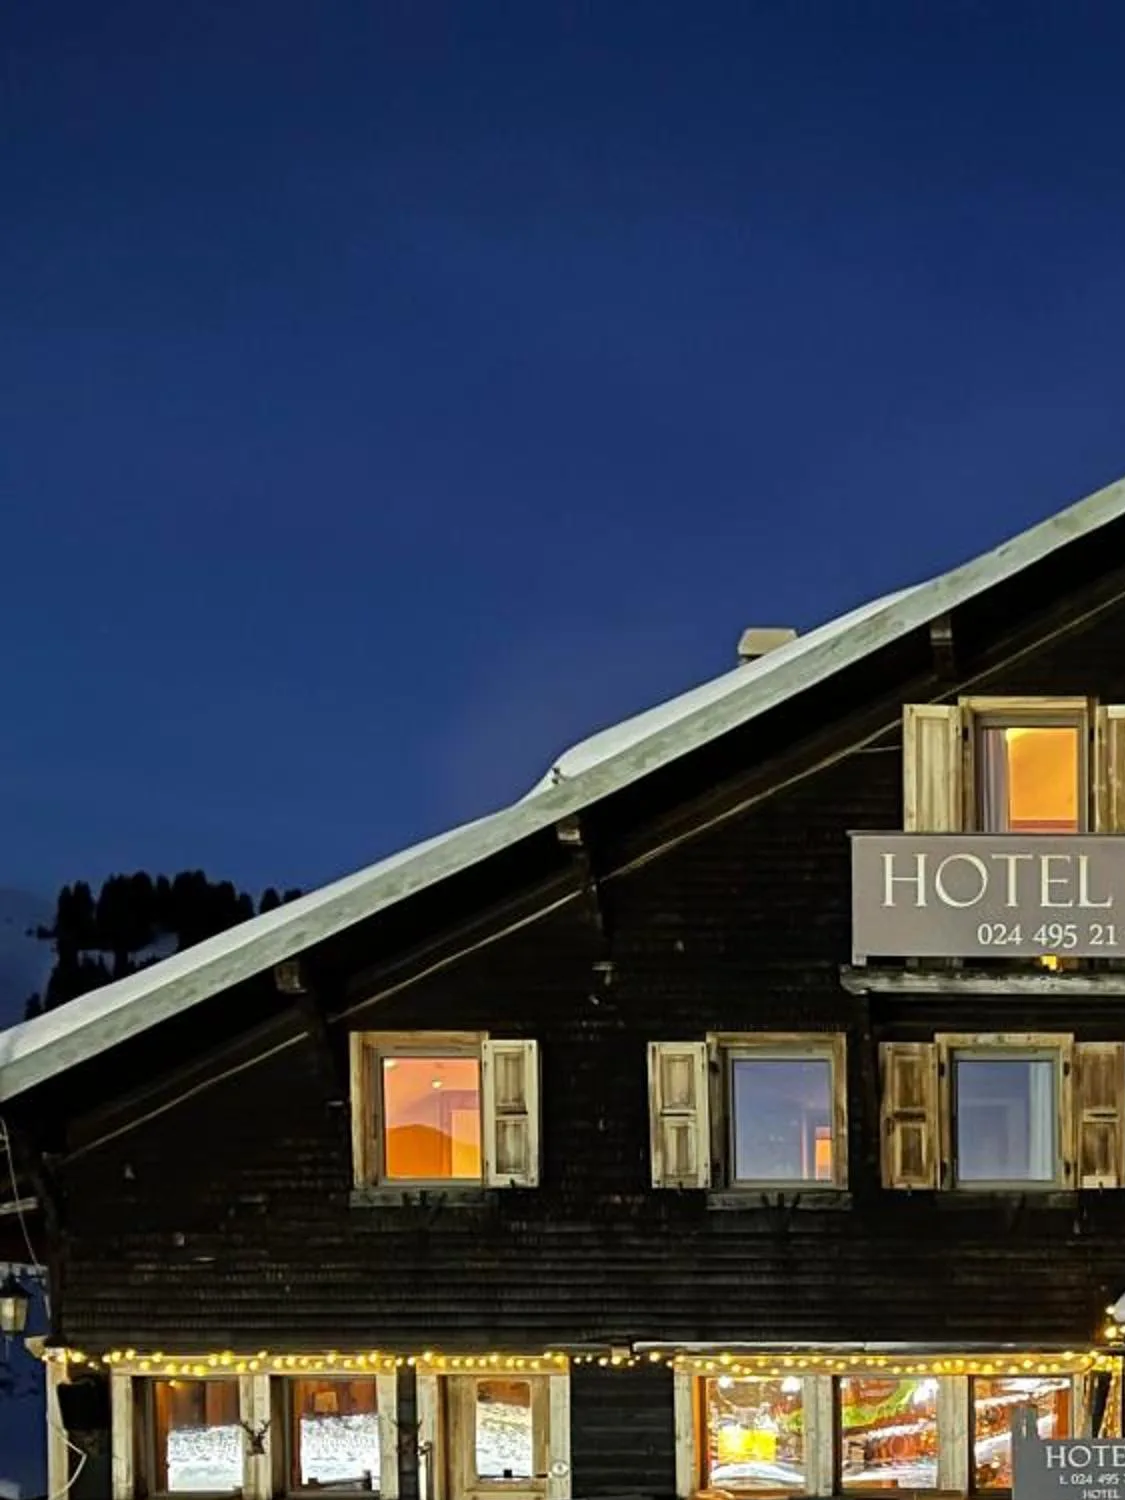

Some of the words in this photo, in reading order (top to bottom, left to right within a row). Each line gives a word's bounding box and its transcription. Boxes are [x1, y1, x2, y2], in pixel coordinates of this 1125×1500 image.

[880, 853, 1113, 908] HOTEL
[976, 924, 1023, 947] 024
[1032, 924, 1078, 948] 495
[1089, 924, 1119, 946] 21
[1070, 1474, 1093, 1485] 024
[1098, 1473, 1120, 1485] 495
[1083, 1488, 1121, 1499] HOTEL
